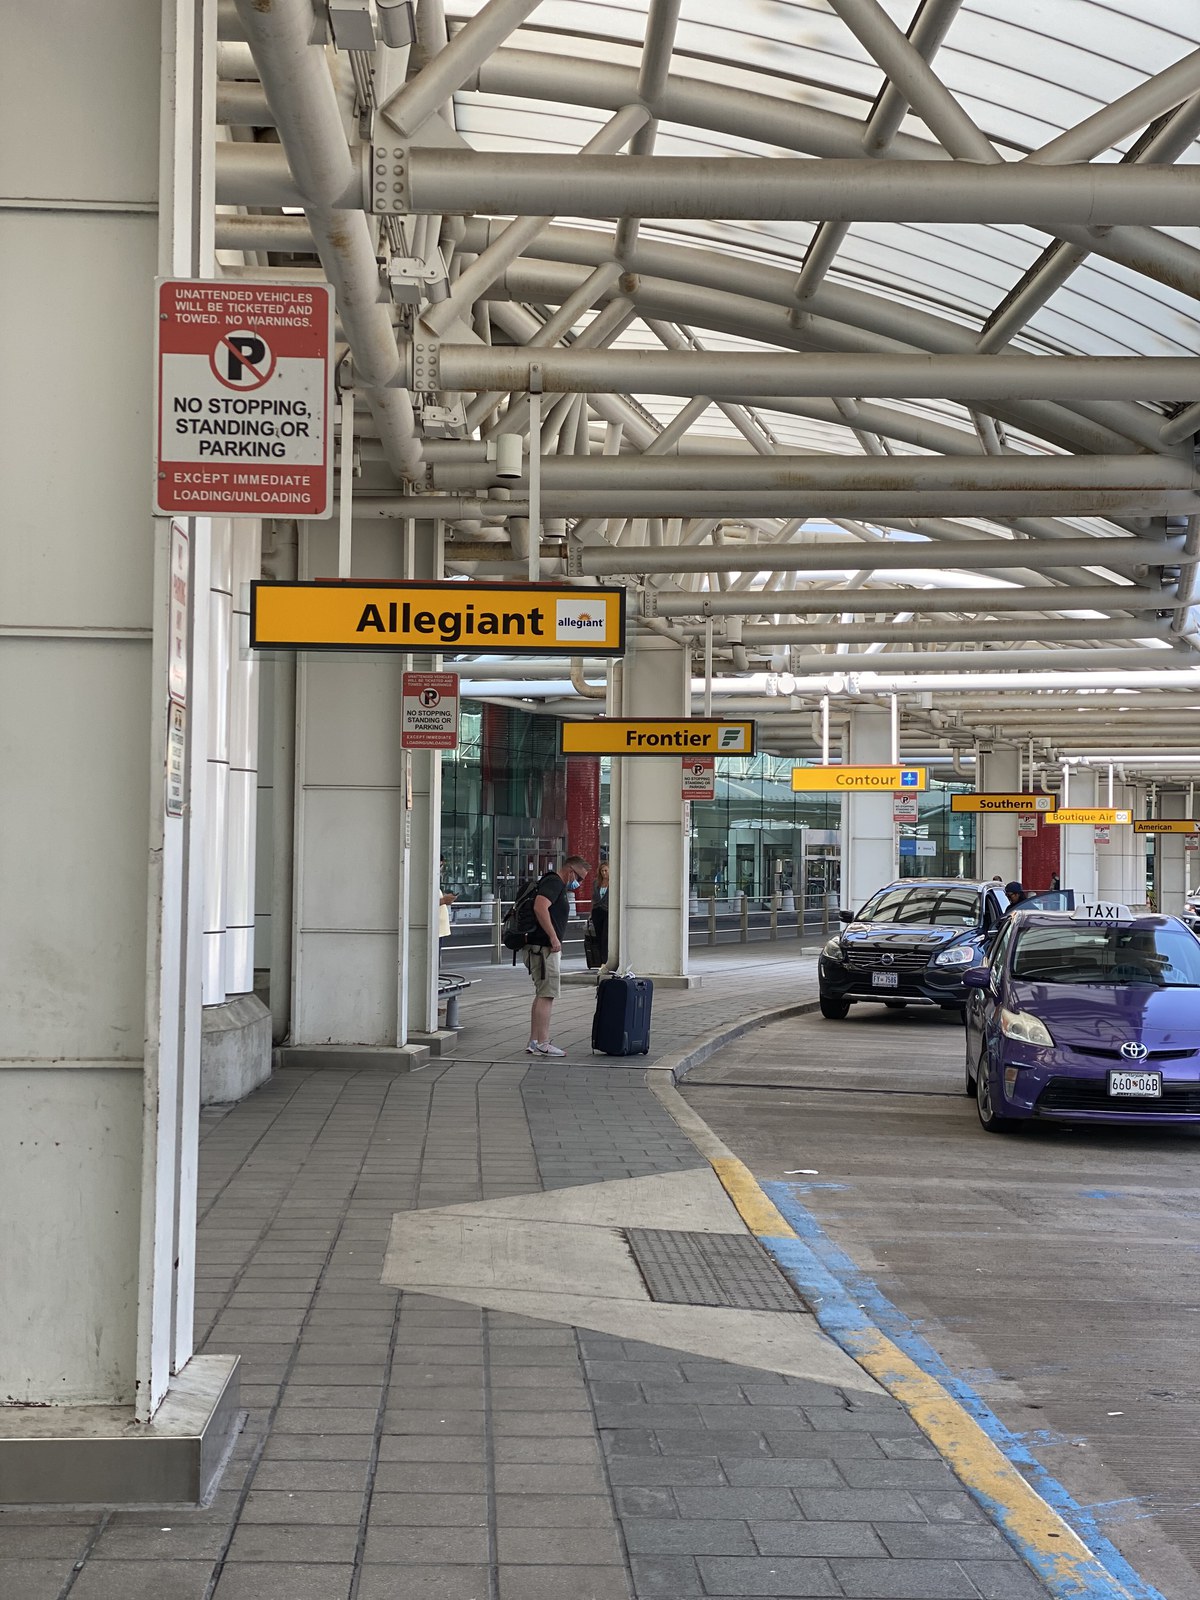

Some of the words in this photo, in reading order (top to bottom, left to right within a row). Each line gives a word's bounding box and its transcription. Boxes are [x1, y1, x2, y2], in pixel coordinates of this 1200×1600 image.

[175, 289, 253, 301] UNATTENDED
[256, 291, 313, 303] VEHICLES
[175, 301, 203, 312] WILL
[207, 302, 223, 312] BE
[227, 303, 284, 314] TICKETED
[288, 304, 313, 315] AND
[175, 313, 221, 324] TOWED.
[225, 314, 242, 325] NO
[247, 316, 313, 327] WARNINGS.
[173, 397, 202, 413] NO
[208, 399, 312, 419] STOPPING,
[176, 419, 275, 436] STANDING
[280, 421, 310, 438] OR
[199, 440, 286, 458] PARKING
[173, 473, 229, 484] EXCEPT
[233, 474, 311, 486] IMMEDIATE
[173, 490, 311, 503] LOADING/UNLOADING
[356, 602, 544, 642] Allegiant
[558, 616, 604, 630] allegiant
[626, 730, 712, 746] Frontier
[836, 774, 896, 785] Contour
[980, 799, 1033, 809] Southern
[1053, 813, 1096, 822] Boutique
[1099, 813, 1113, 821] Air
[1138, 823, 1173, 831] American
[1086, 904, 1119, 918] TAXI
[1112, 1078, 1132, 1090] 660
[1139, 1078, 1158, 1091] 06B
